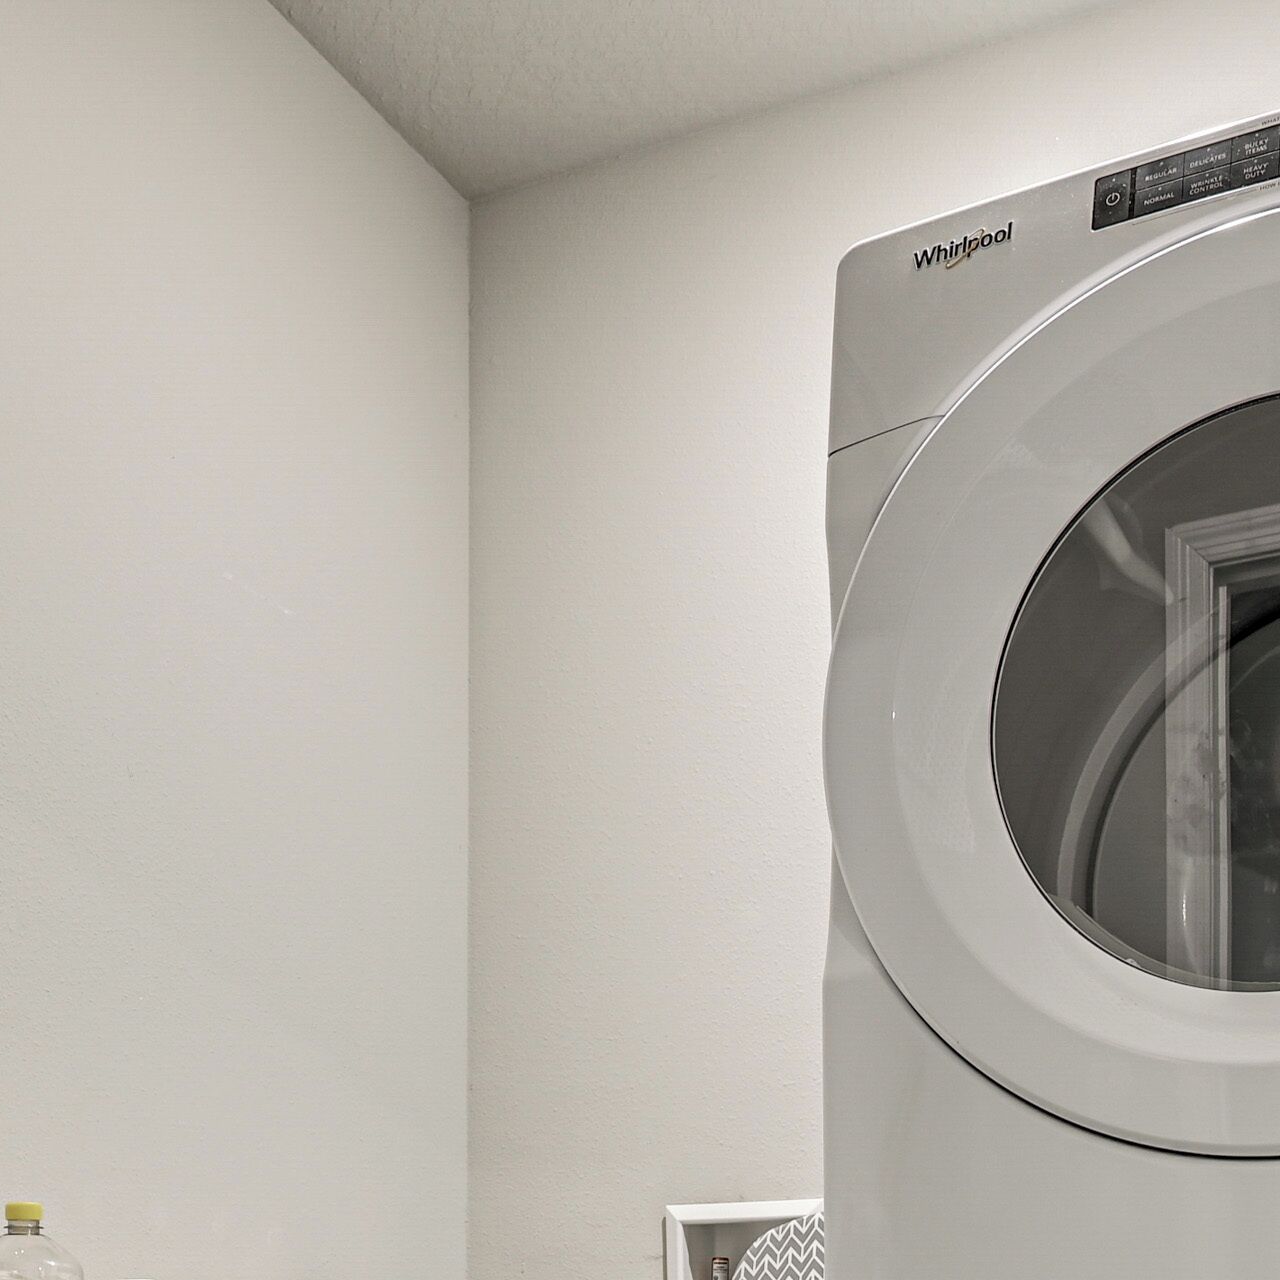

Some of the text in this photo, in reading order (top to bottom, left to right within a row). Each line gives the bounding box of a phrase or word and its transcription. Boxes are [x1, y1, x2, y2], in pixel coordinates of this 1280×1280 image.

[1244, 137, 1268, 149] BULKY
[1245, 145, 1268, 156] ITEMS
[1189, 153, 1226, 168] DELICATES
[1145, 167, 1177, 182] REGULAR
[1243, 163, 1269, 175] HEAVY
[1245, 170, 1265, 180] DUTY
[1189, 182, 1224, 195] CONTROL
[1190, 175, 1222, 189] WRINKLE
[1143, 191, 1174, 205] NORMAL
[913, 221, 1013, 269] Whirlpool
